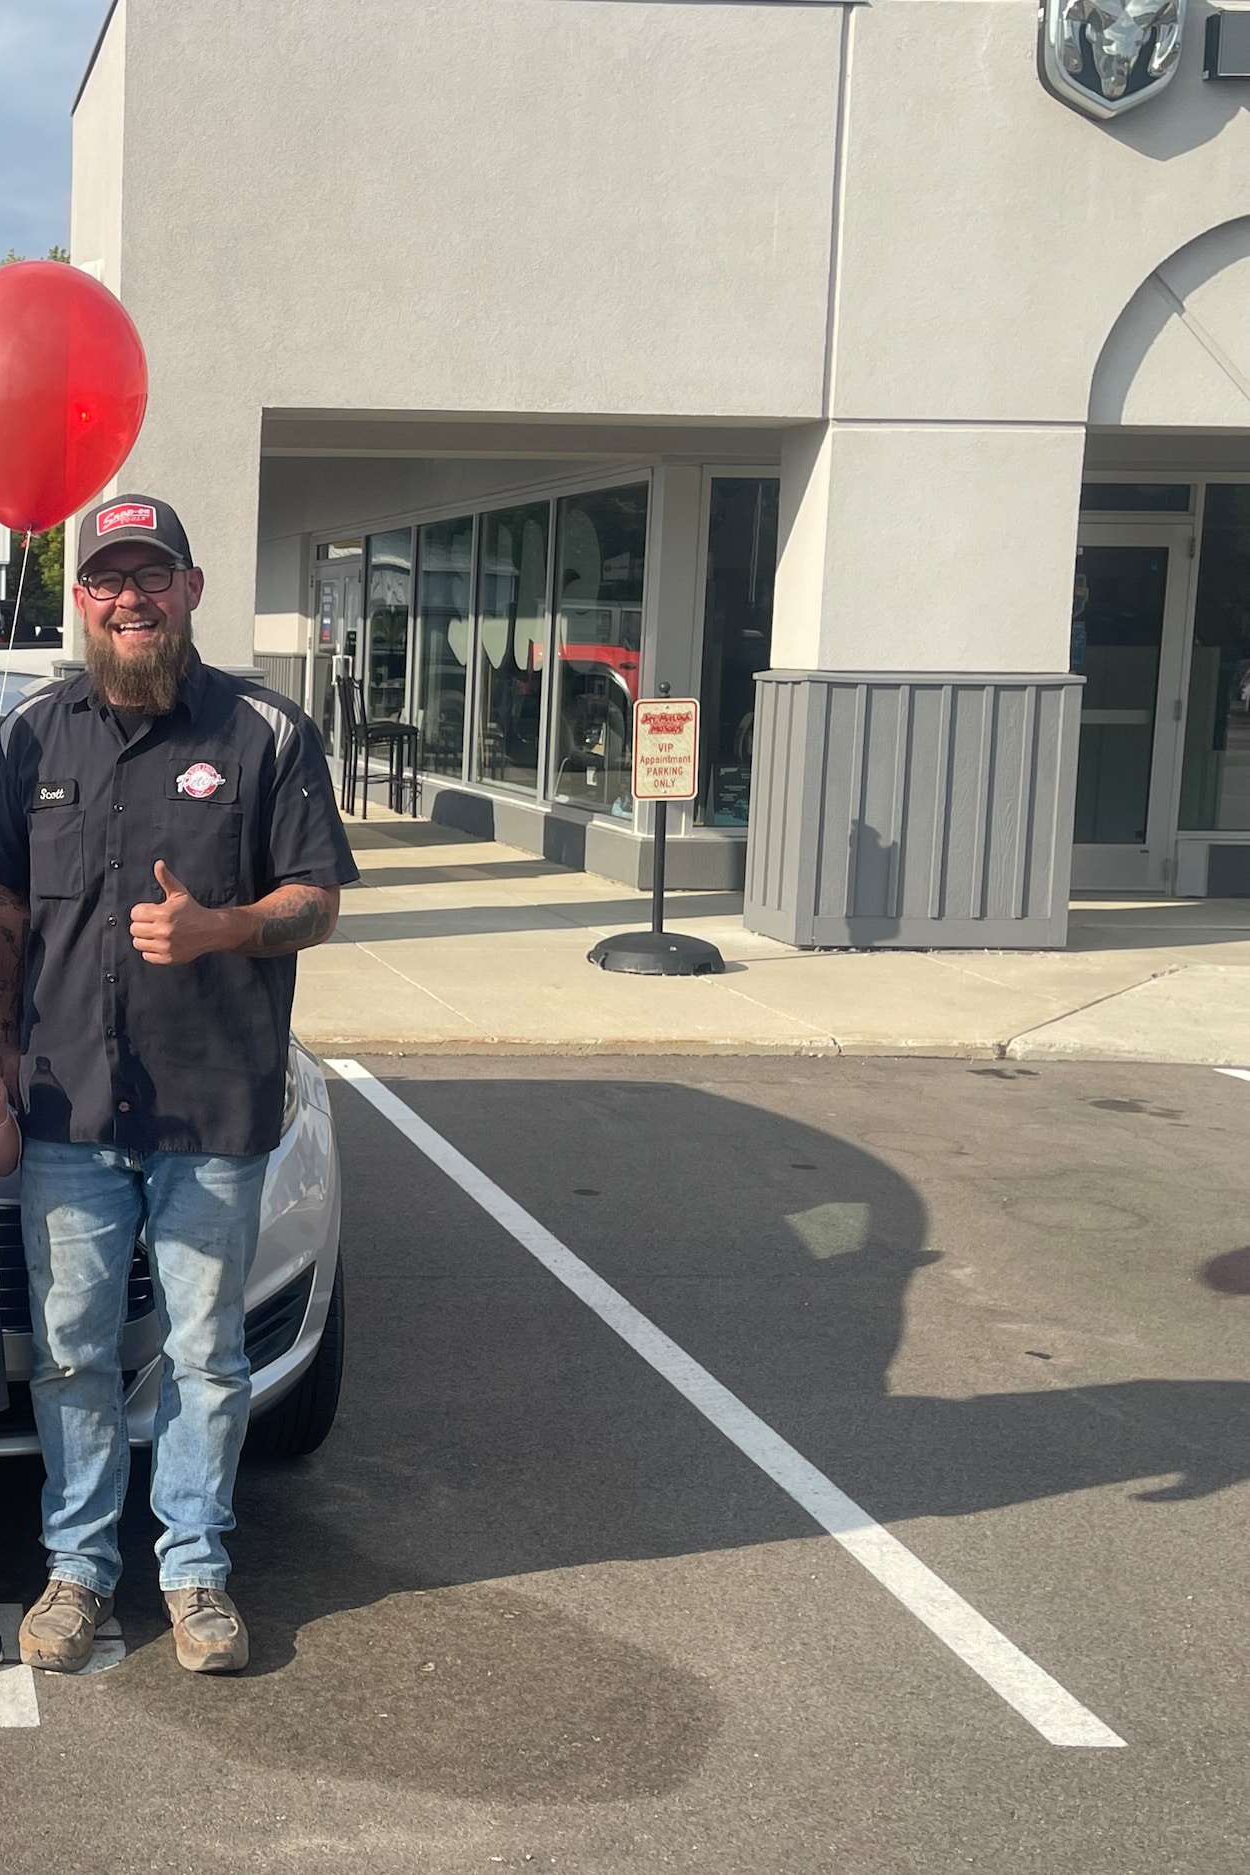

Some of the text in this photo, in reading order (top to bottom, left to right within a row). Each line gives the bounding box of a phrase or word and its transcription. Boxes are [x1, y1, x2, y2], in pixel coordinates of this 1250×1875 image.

[658, 743, 674, 753] VIP
[640, 755, 691, 766] Appointment
[646, 766, 683, 776] PARKING
[654, 779, 676, 789] ONLY
[39, 787, 65, 800] Scott
